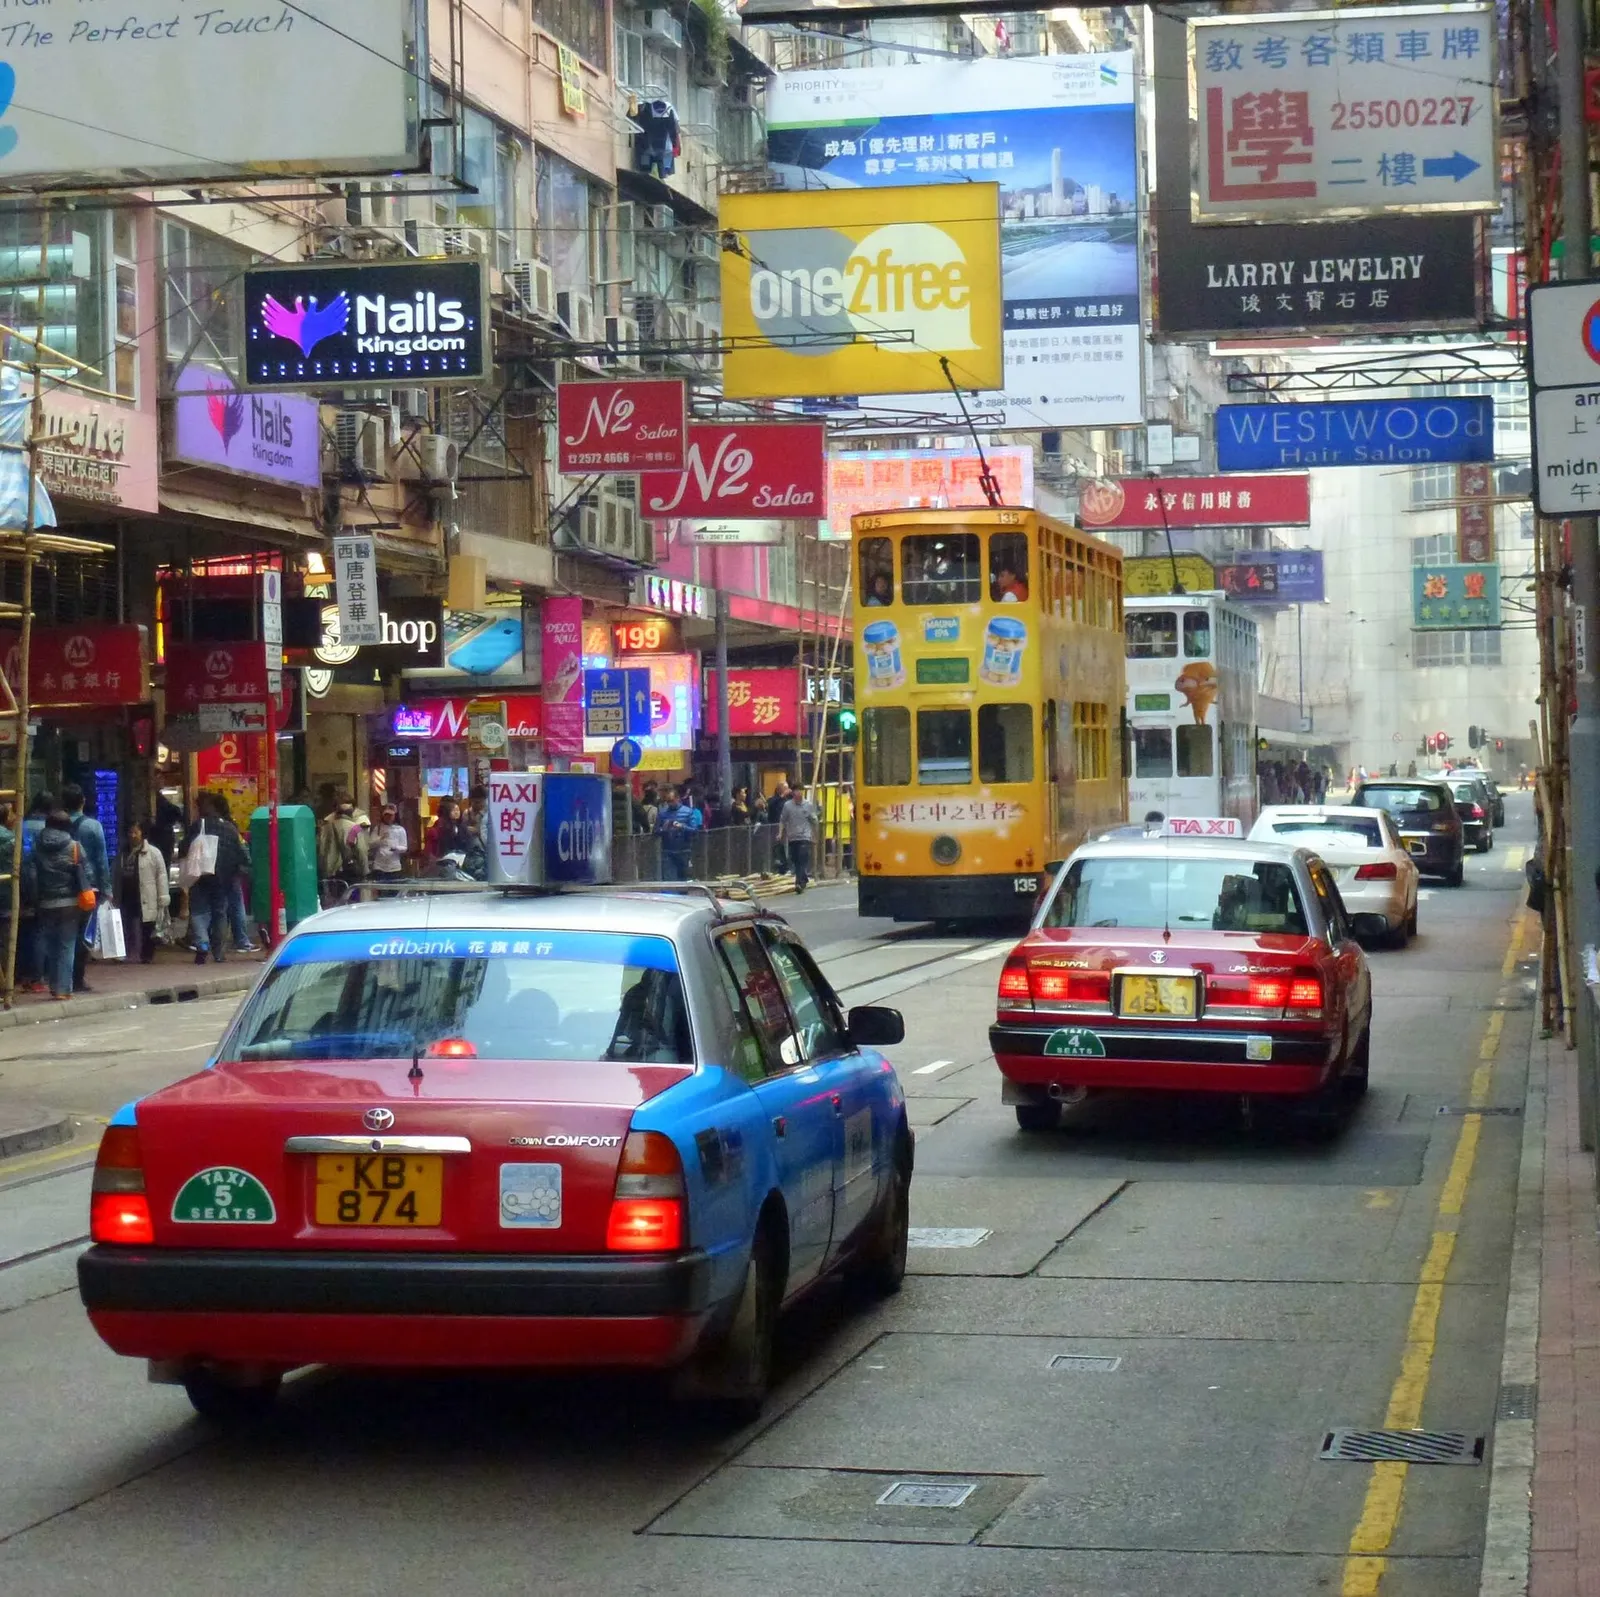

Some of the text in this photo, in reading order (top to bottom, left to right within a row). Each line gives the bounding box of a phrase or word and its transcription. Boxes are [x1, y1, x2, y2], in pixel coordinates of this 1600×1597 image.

[2, 8, 294, 47] The Perfect Touch
[1330, 96, 1475, 130] 25500227
[1328, 152, 1417, 187] 二樓
[1207, 254, 1424, 288] LARRY JEWELRY
[751, 248, 970, 319] one2free
[357, 291, 465, 334] Nails
[358, 337, 466, 356] Kingdom
[251, 395, 293, 448] Nails
[564, 388, 678, 446] N2 Salon
[1568, 414, 1600, 434] 上
[252, 442, 294, 469] Kingdom
[1281, 443, 1431, 464] Hair Salon
[650, 432, 814, 512] N2 Salon
[1547, 457, 1600, 477] midn
[1144, 490, 1252, 511] 永亨信用財務
[1570, 482, 1600, 503] 午
[861, 519, 881, 529] 135
[338, 543, 370, 559] 西醫
[346, 561, 368, 622] 唐登華
[380, 612, 437, 653] hop
[545, 623, 576, 634] DECO
[553, 633, 579, 645] NAIL
[616, 626, 661, 650] 199
[507, 720, 538, 736] alon
[602, 724, 620, 732] 4-7
[490, 784, 537, 803] TAXI
[891, 802, 1007, 823] 果仁中之皇者
[500, 808, 526, 856] 的士
[1169, 819, 1236, 835] TAXI
[1013, 878, 1037, 892] 135
[369, 939, 553, 956] citibank 花旗銀行
[1056, 1047, 1093, 1055] SEATS
[1068, 1035, 1080, 1047] 4
[509, 1135, 621, 1147] CROWN COMFORT
[202, 1170, 247, 1188] TAXI
[354, 1156, 406, 1190] KB
[213, 1185, 233, 1207] 5
[337, 1190, 419, 1223] 874
[191, 1207, 257, 1220] SEATS
